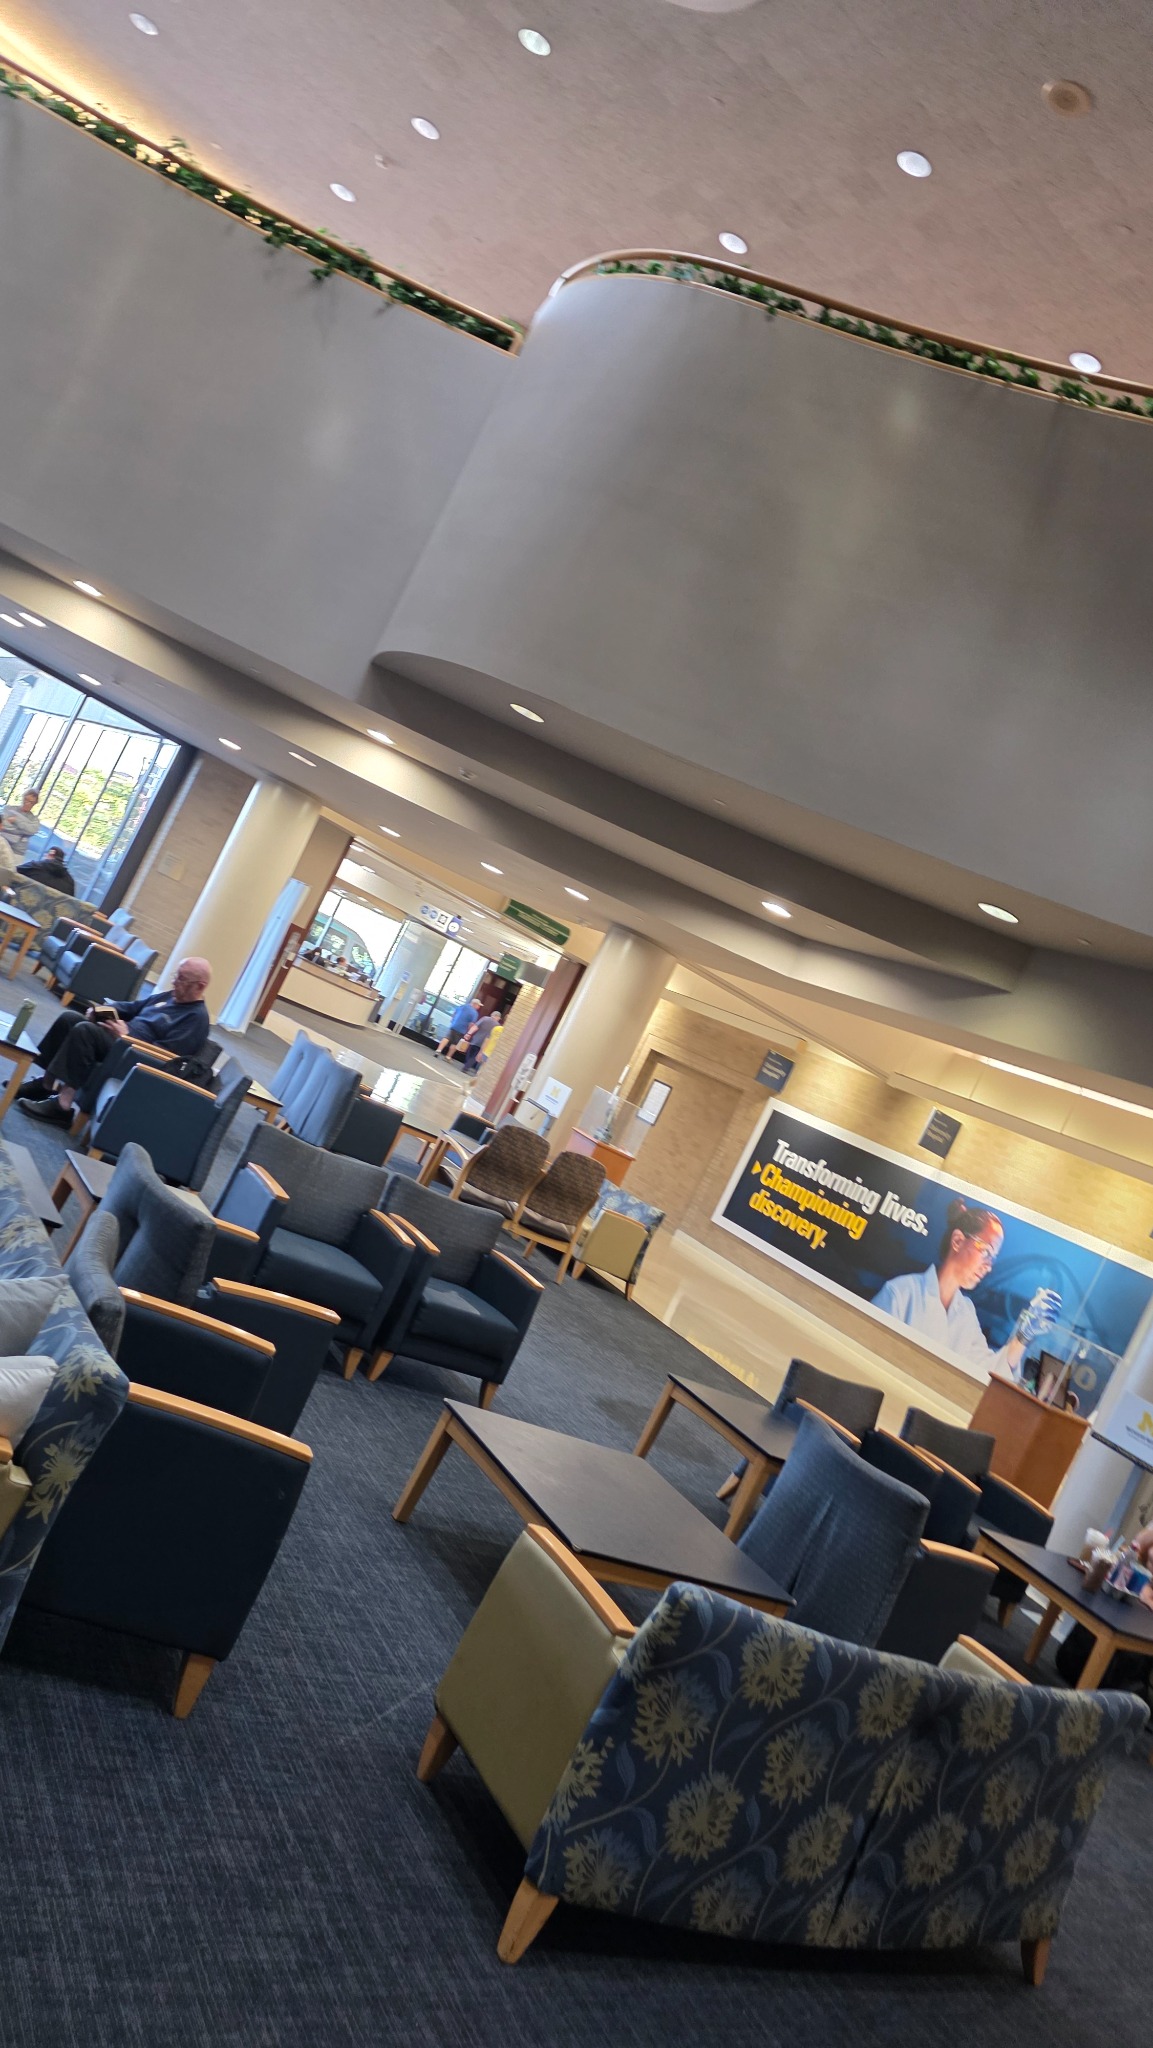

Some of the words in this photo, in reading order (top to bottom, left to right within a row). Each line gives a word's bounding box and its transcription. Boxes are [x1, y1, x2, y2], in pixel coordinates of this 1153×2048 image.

[749, 1190, 829, 1250] discovery.
[760, 1163, 868, 1240] Championing
[772, 1140, 881, 1214] Transforming
[880, 1191, 929, 1236] lives.
